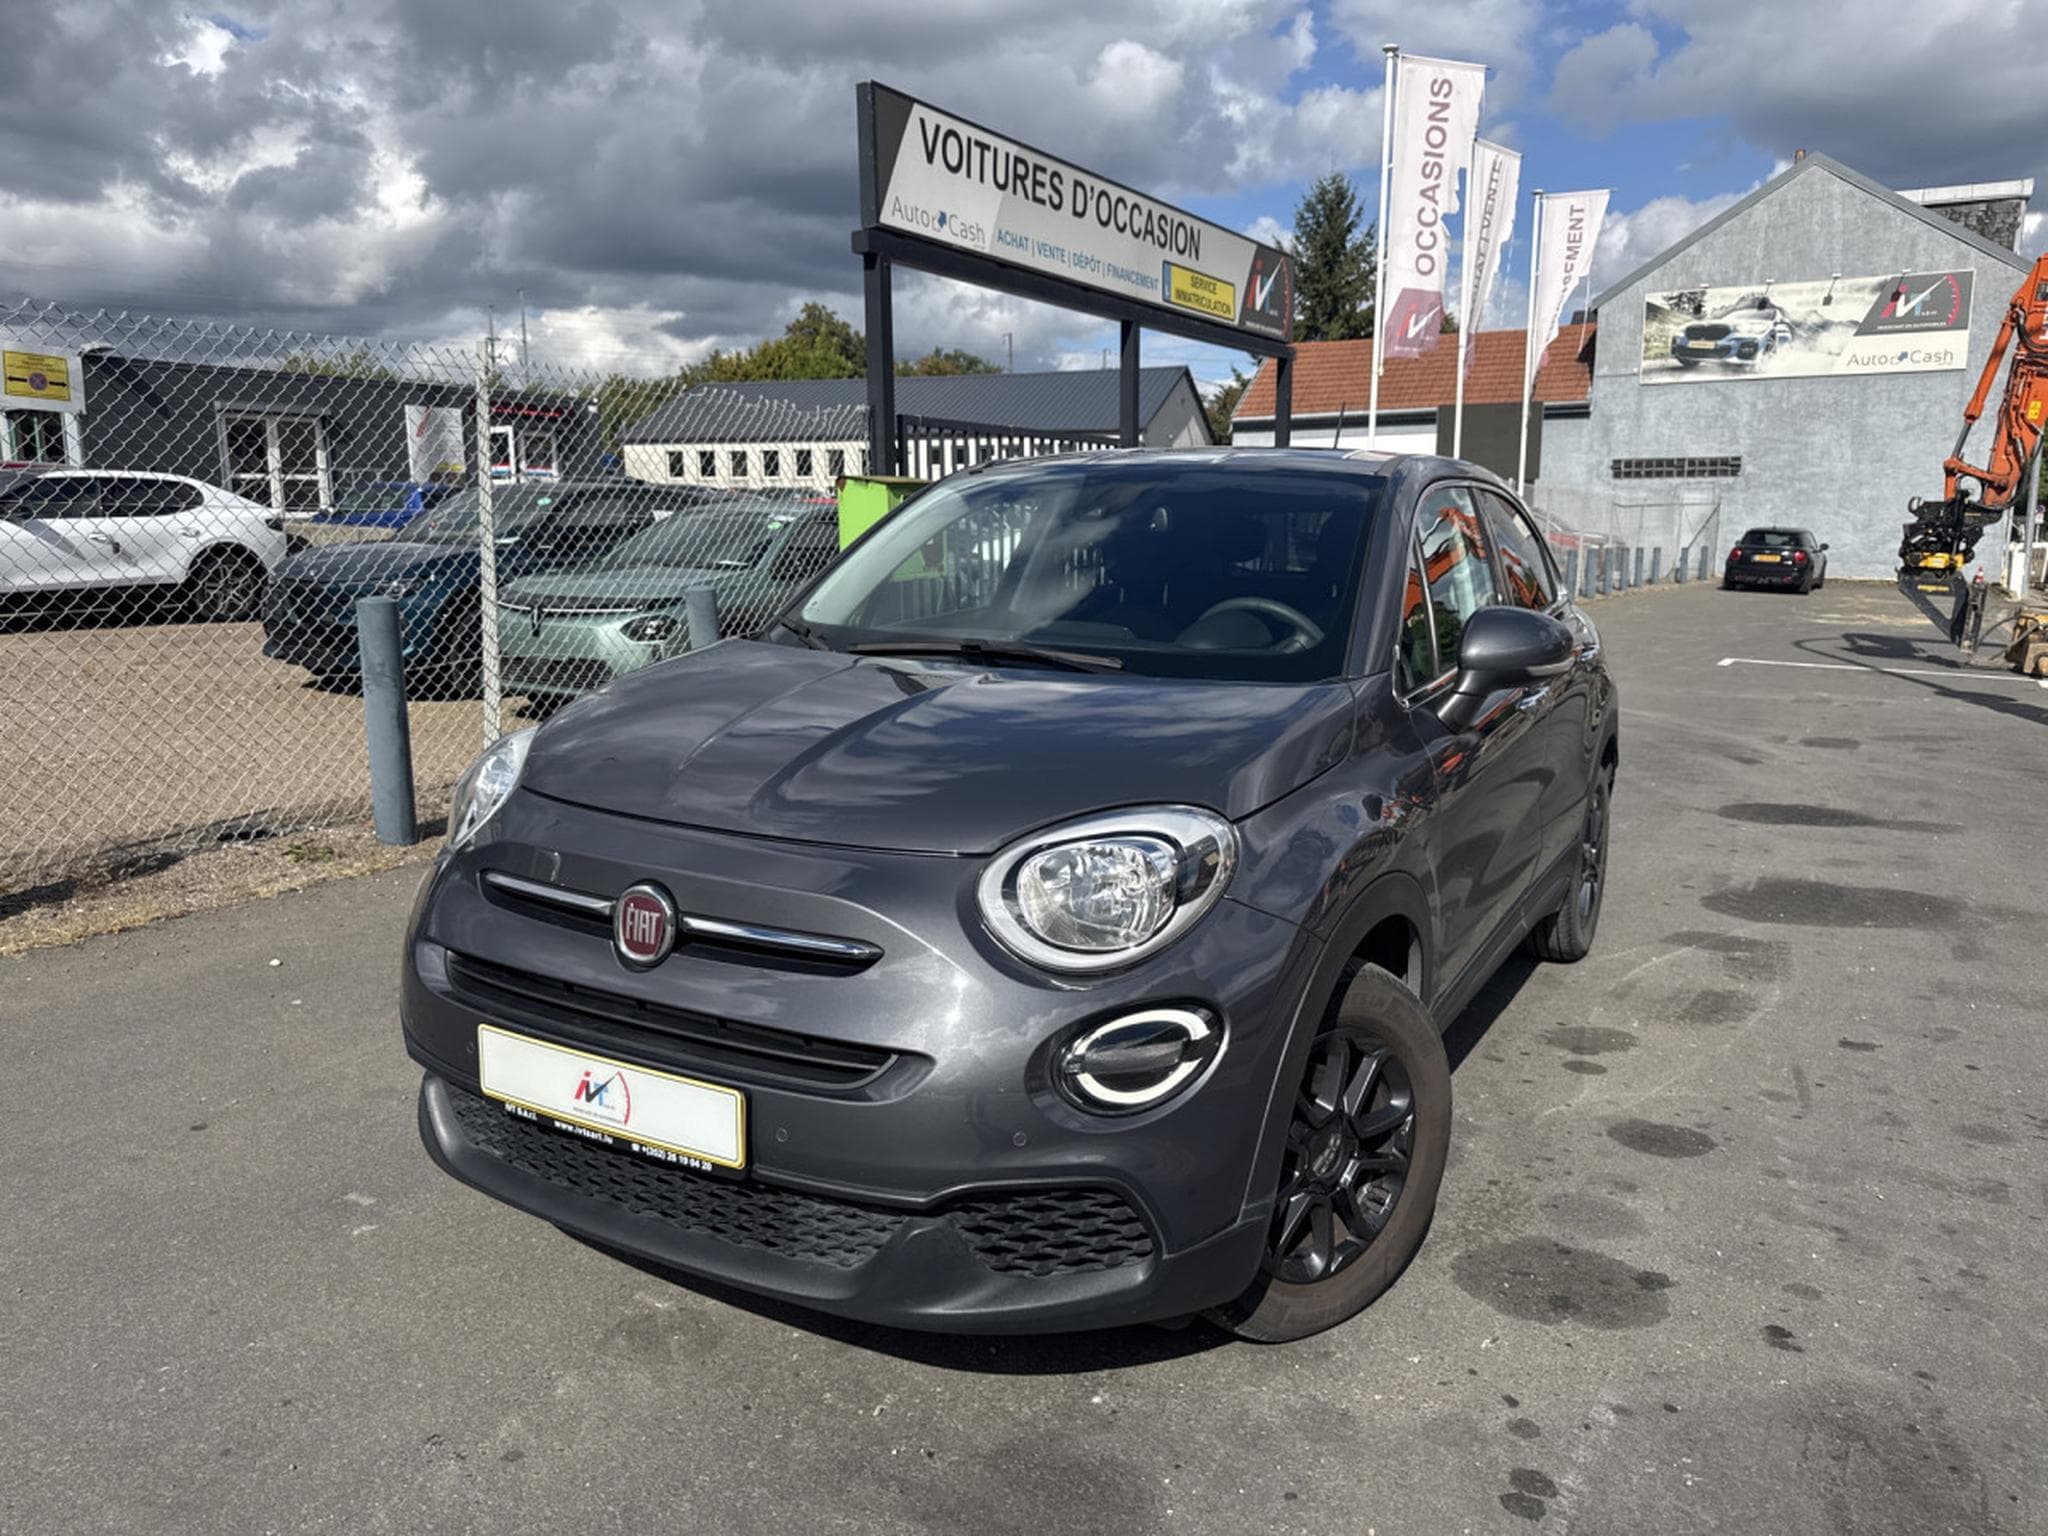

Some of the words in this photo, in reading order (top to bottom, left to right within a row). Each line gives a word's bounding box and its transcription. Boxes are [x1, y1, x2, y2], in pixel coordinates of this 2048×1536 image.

[919, 117, 1064, 211] VOITURES
[1072, 179, 1201, 261] D'OCCASION
[1415, 78, 1452, 276] OCCASIONS
[997, 230, 1029, 250] ACHAT
[1037, 240, 1066, 264] VENTE
[1073, 251, 1101, 273] DÉPÔT
[1107, 263, 1159, 290] FINANCEMENT
[1190, 275, 1217, 295] SERVICE
[625, 906, 660, 945] FIAT
